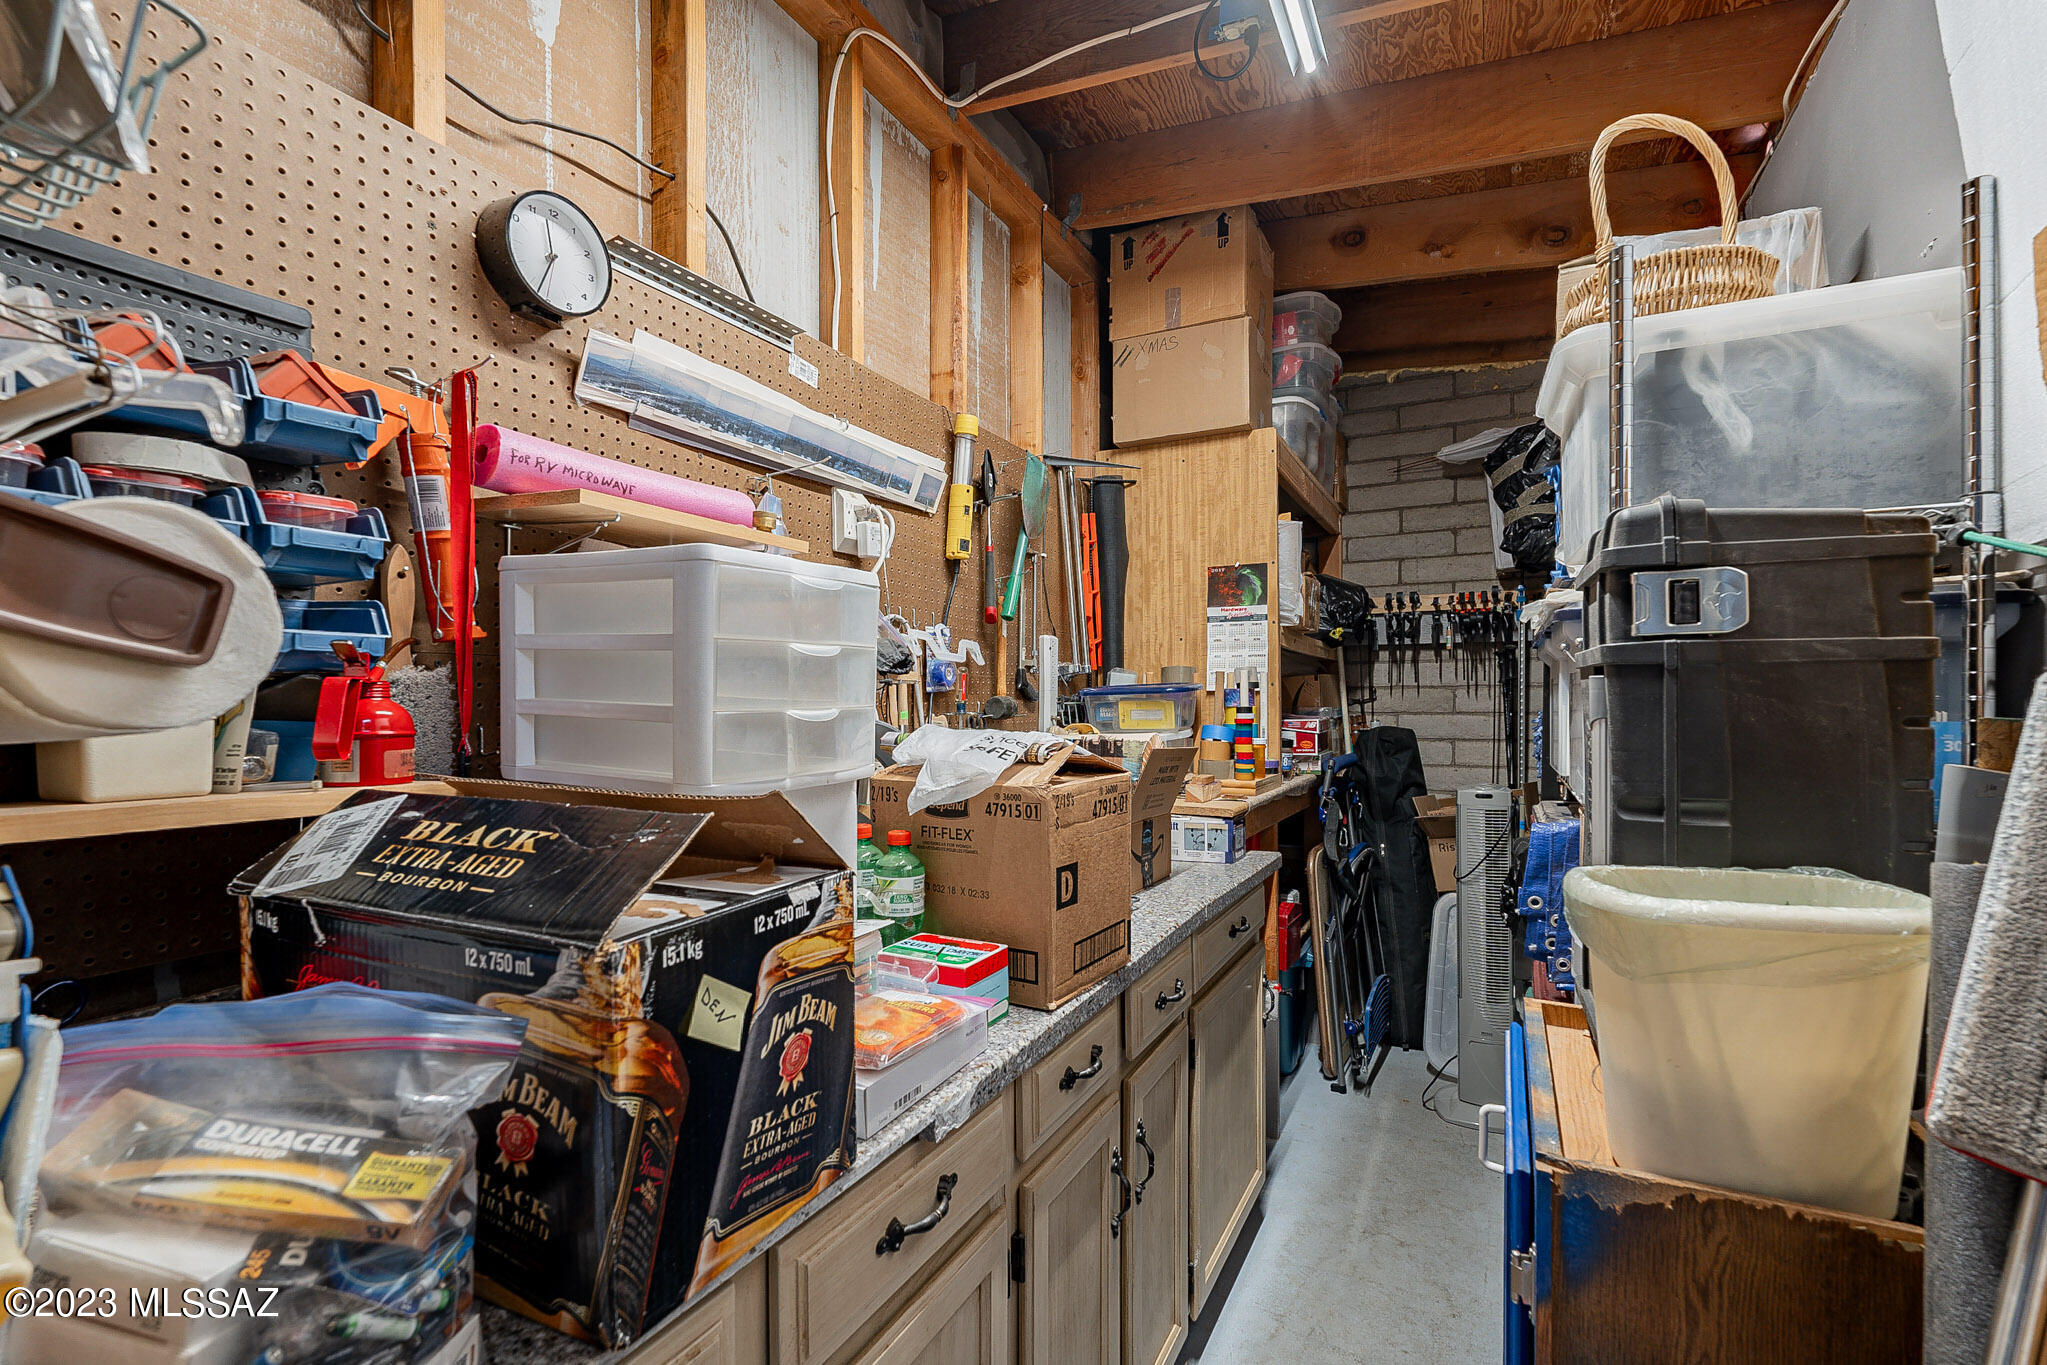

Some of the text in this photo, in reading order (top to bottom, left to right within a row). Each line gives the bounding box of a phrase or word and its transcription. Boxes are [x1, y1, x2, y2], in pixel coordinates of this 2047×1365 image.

[548, 208, 560, 220] 12
[584, 250, 591, 259] 2
[1217, 238, 1229, 249] UP
[1123, 260, 1134, 271] UP
[588, 274, 594, 282] 3
[566, 302, 573, 311] 5
[581, 293, 588, 301] 4
[1135, 336, 1180, 360] XMAS
[562, 464, 637, 496] MICROWAVE
[1003, 793, 1022, 802] 36000
[1105, 784, 1118, 796] 36000
[985, 802, 1040, 819] 47915 01
[1092, 797, 1117, 819] 47915
[401, 820, 545, 853] BLACK
[921, 825, 973, 842] FIT-FLEX
[1438, 842, 1457, 852] Ris
[372, 844, 524, 880] EXTRA-AGED
[377, 871, 469, 893] BOURBON
[1061, 870, 1074, 903] D
[968, 889, 990, 899] 02:33
[754, 914, 766, 935] 12
[774, 906, 794, 928] 750
[796, 900, 811, 919] mL
[465, 947, 477, 967] 12
[489, 950, 513, 974] 750
[515, 956, 535, 977] mL
[662, 940, 703, 968] 15.1 kg
[701, 987, 737, 1023] DEN
[761, 993, 838, 1060] JIM BEAM
[520, 1072, 579, 1150] BEAM
[747, 1092, 820, 1138] BLACK
[202, 1118, 361, 1158] DURACELL
[743, 1111, 817, 1160] EXTRA-AGED
[754, 1136, 800, 1165] BOURBON
[477, 1171, 550, 1223] LACK
[367, 1224, 401, 1240] 9V
